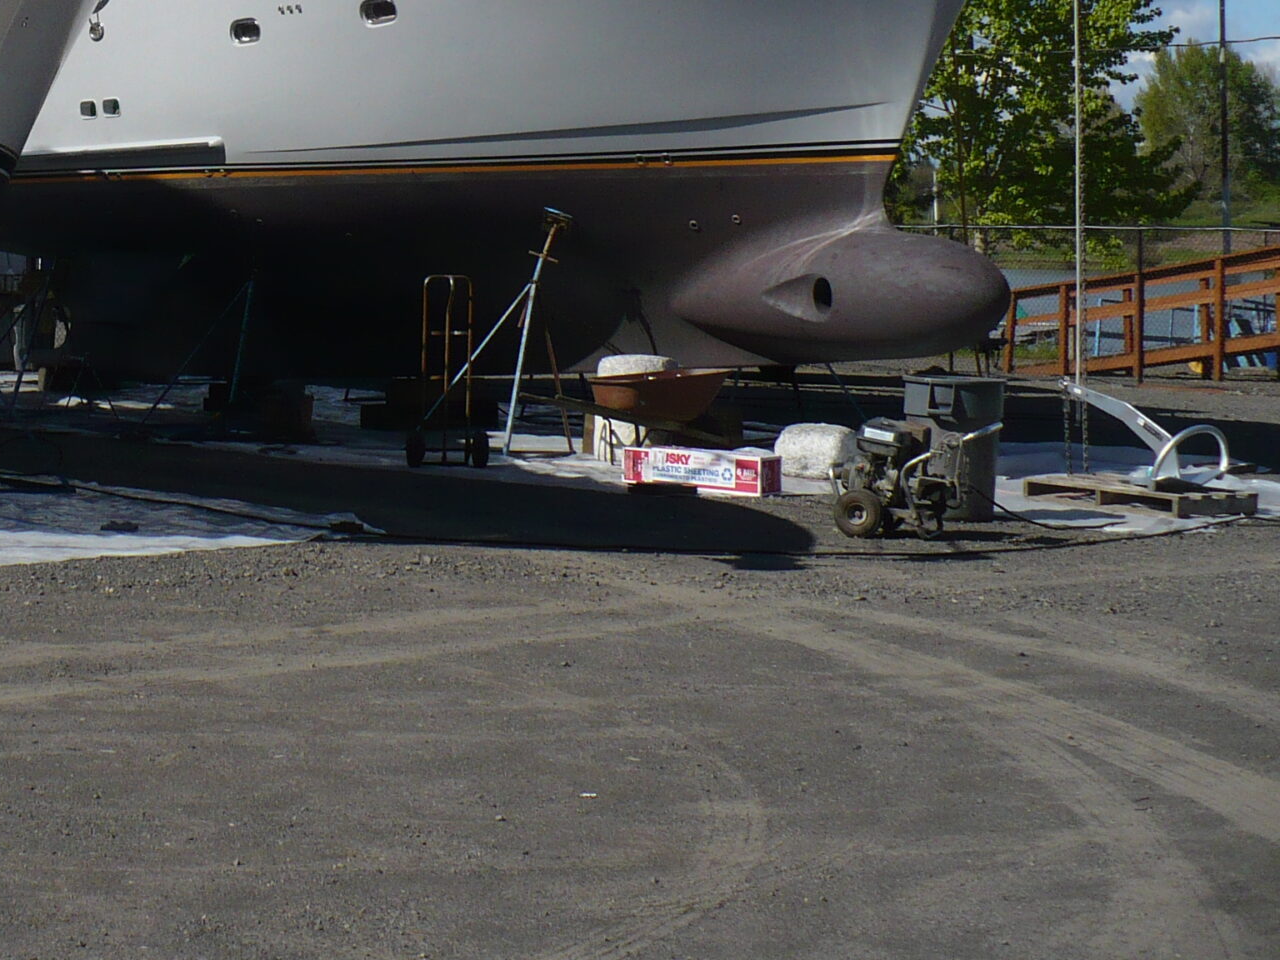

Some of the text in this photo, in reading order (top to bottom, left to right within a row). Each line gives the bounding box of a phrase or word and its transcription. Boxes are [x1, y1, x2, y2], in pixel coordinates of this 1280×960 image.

[658, 452, 691, 465] SKY
[652, 465, 719, 477] PLASTIC SHEETING
